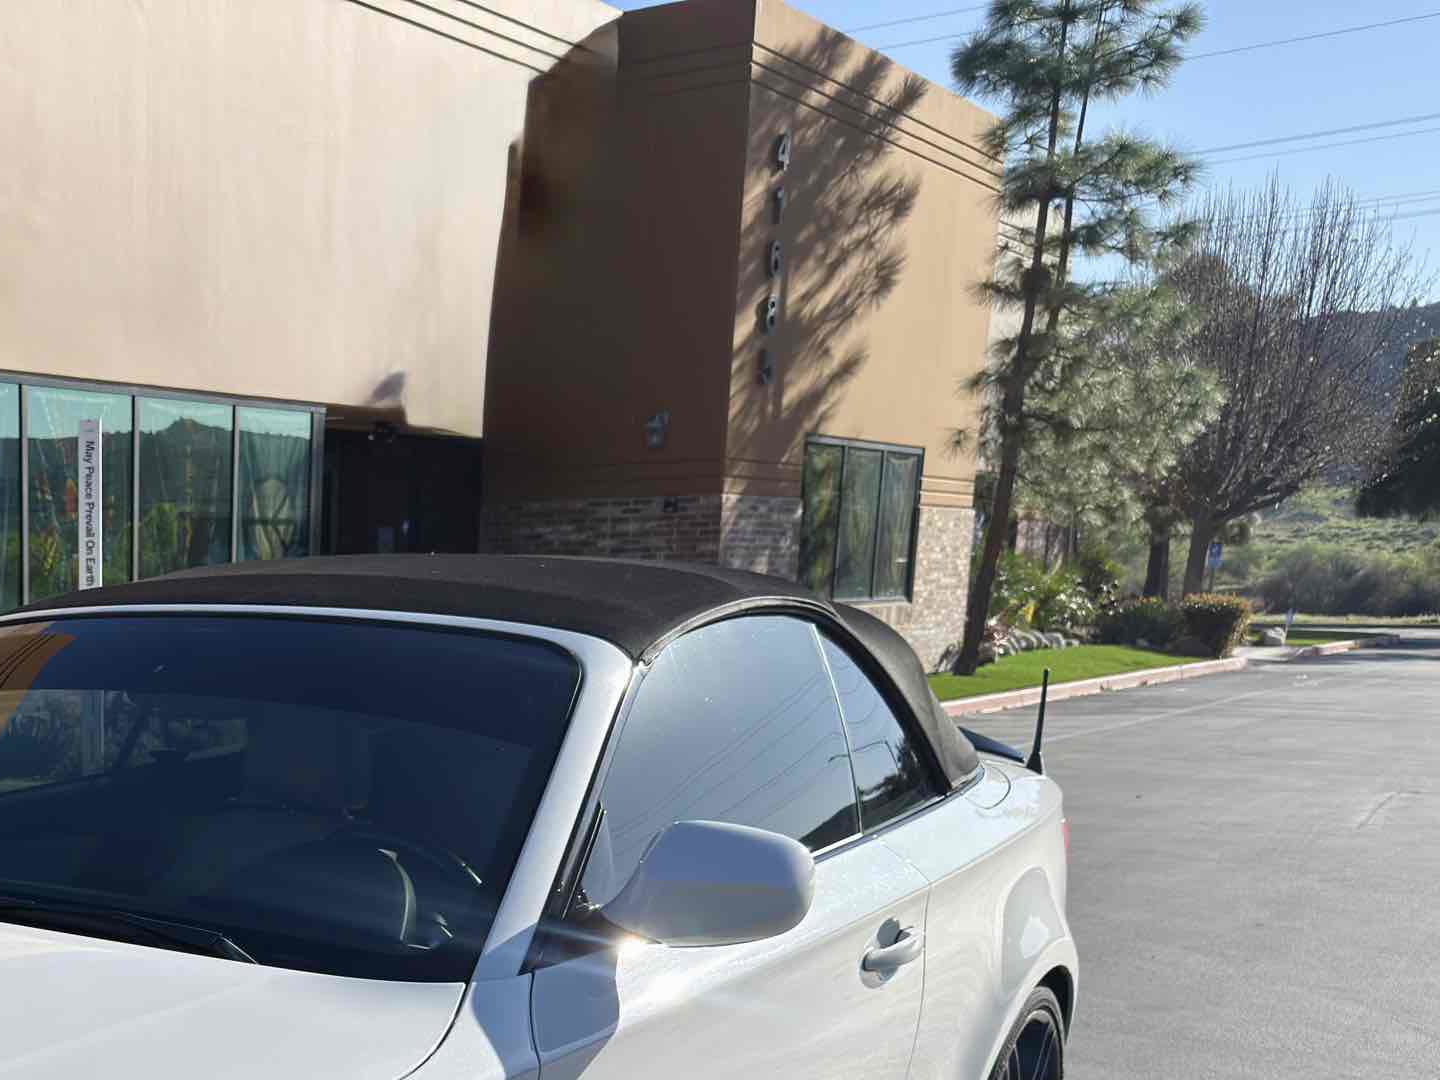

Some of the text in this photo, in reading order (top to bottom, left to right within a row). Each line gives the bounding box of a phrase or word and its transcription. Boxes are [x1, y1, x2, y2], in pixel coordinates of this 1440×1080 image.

[83, 440, 96, 587] May Peace Prevail On Earth
